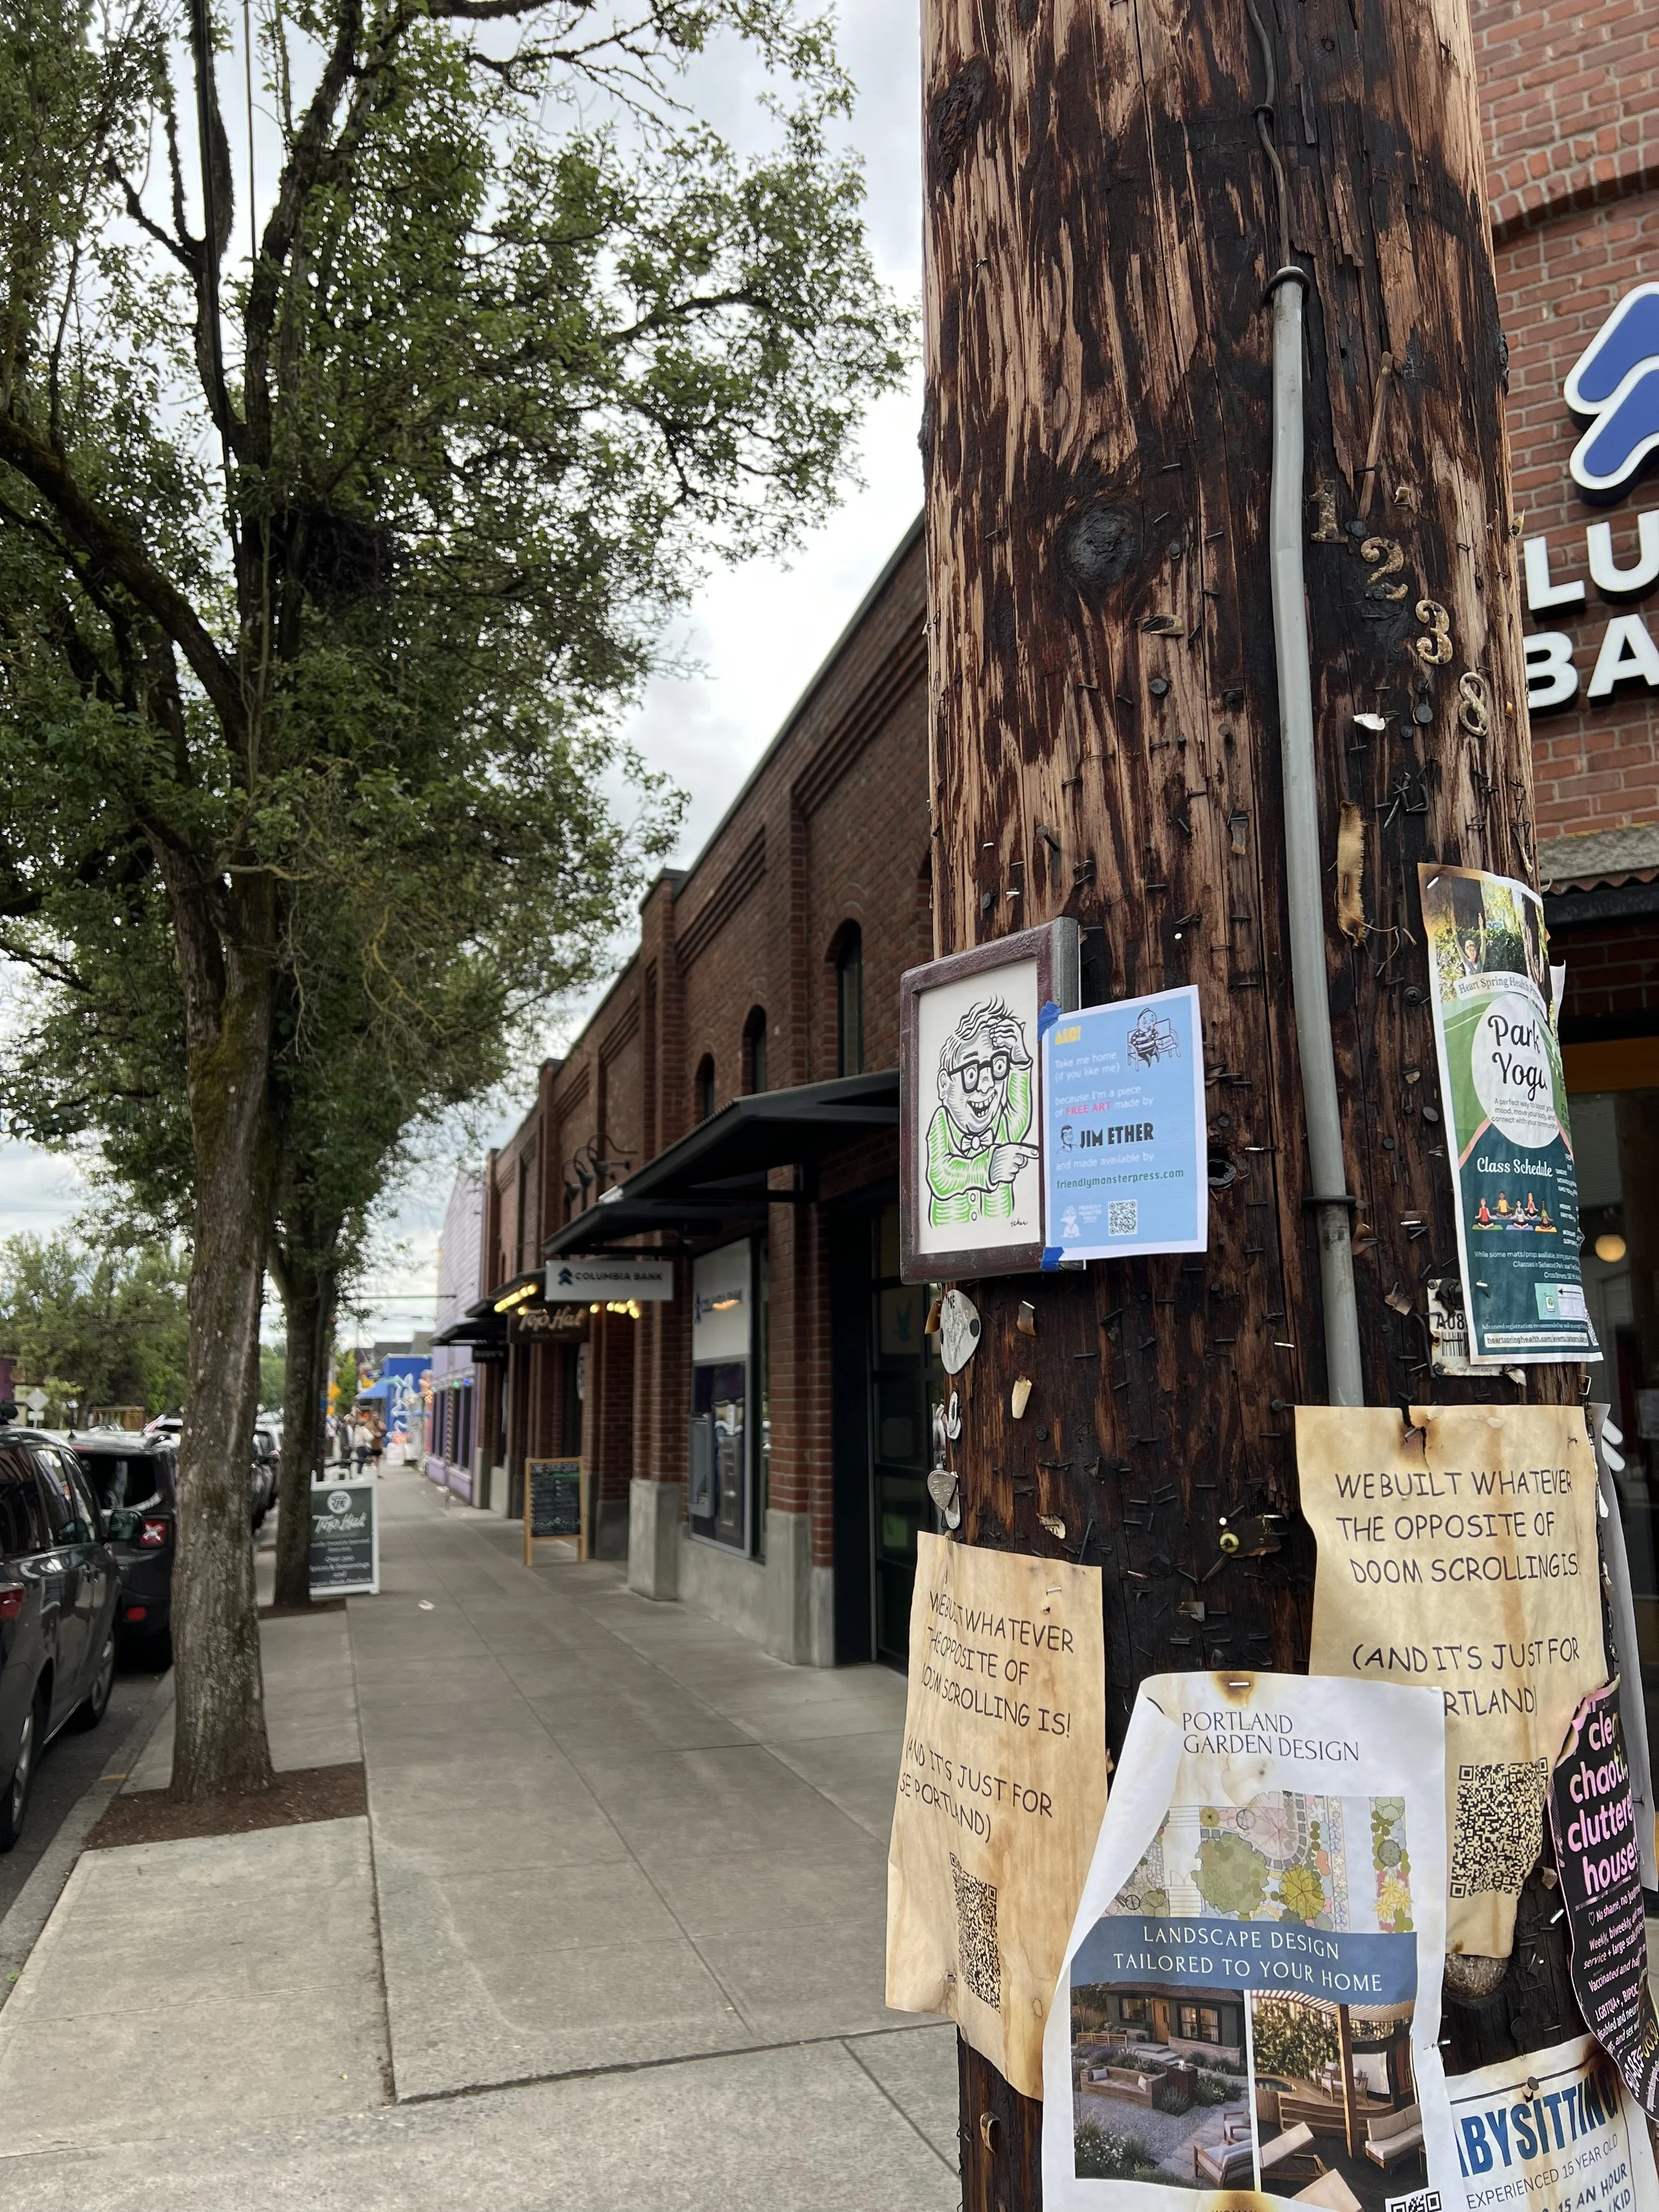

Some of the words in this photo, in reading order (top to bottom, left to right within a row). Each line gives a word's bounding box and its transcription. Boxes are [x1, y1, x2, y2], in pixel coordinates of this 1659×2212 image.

[1458, 981, 1480, 994] Heart
[1480, 976, 1508, 988] Spring
[1488, 1015, 1540, 1054] Park
[1054, 1059, 1074, 1069] Take
[1076, 1056, 1090, 1065] me
[1092, 1051, 1118, 1063] home
[1066, 1070, 1082, 1082] you
[1084, 1067, 1099, 1076] like
[1102, 1063, 1120, 1073] me)
[1054, 1093, 1089, 1106] because
[1118, 1085, 1141, 1098] piece
[1054, 1109, 1064, 1118] of
[1065, 1104, 1089, 1116] FREE
[1092, 1102, 1112, 1113] ART
[1115, 1098, 1141, 1109] made
[1142, 1096, 1154, 1106] by
[1080, 1129, 1103, 1149] JIM
[1108, 1122, 1154, 1145] ETHER
[1055, 1160, 1071, 1171] and
[1074, 1158, 1097, 1168] made
[1100, 1153, 1140, 1166] available
[1143, 1151, 1155, 1163] by
[1477, 1157, 1511, 1173] Class
[1513, 1158, 1553, 1177] Schedule
[1056, 1169, 1184, 1189] friendlymonsterpress.com
[575, 1272, 631, 1280] COLUMBIA
[633, 1272, 662, 1280] BANK
[1471, 1469, 1573, 1496] WHATEVER
[1335, 1515, 1386, 1542] THE
[1394, 1511, 1527, 1540] OPPOSITE
[1534, 1511, 1555, 1538] OF
[1350, 1557, 1424, 1584] DOOM
[1431, 1554, 1559, 1582] SCROLLING
[966, 1609, 1074, 1653] WHATEVER
[940, 1635, 998, 1678] OPPOSITE
[1004, 1659, 1029, 1686] OF
[1491, 1639, 1544, 1670] JUST
[1548, 1637, 1581, 1662] FOR
[941, 1678, 1031, 1728] SCROLLING
[1037, 1708, 1071, 1738] IS!
[1182, 1710, 1293, 1735] PORTLAND
[1183, 1734, 1273, 1756] GARDEN
[1279, 1739, 1360, 1763] DESIGN
[958, 1764, 1007, 1801] JUST
[1012, 1783, 1052, 1818] FOR
[899, 1772, 911, 1797] SE
[914, 1779, 991, 1844] PORTLAND)
[1567, 1789, 1634, 1852] cluttere
[1621, 1895, 1628, 1906] no
[1143, 1925, 1262, 1949] LANDSCAPE
[1270, 1932, 1340, 1961] DESIGN
[1583, 1953, 1607, 1970] service
[1612, 1940, 1626, 1955] large
[1113, 1953, 1214, 1976] TAILORED
[1222, 1958, 1251, 1978] TO
[1258, 1960, 1315, 1985] YOUR
[1322, 1970, 1383, 1993] HOME
[1588, 1965, 1619, 1993] Vaccinated
[1619, 1958, 1631, 1975] and
[1622, 1982, 1640, 2002] BIPOC
[1615, 2028, 1626, 2045] and
[1467, 2168, 1559, 2210] EXPERIENCED
[1562, 2161, 1574, 2179] 15
[1575, 2146, 1602, 2172] YEAR
[1603, 2133, 1619, 2156] OLD
[1576, 2185, 1597, 2209] AN
[1600, 2162, 1628, 2198] HOUR
